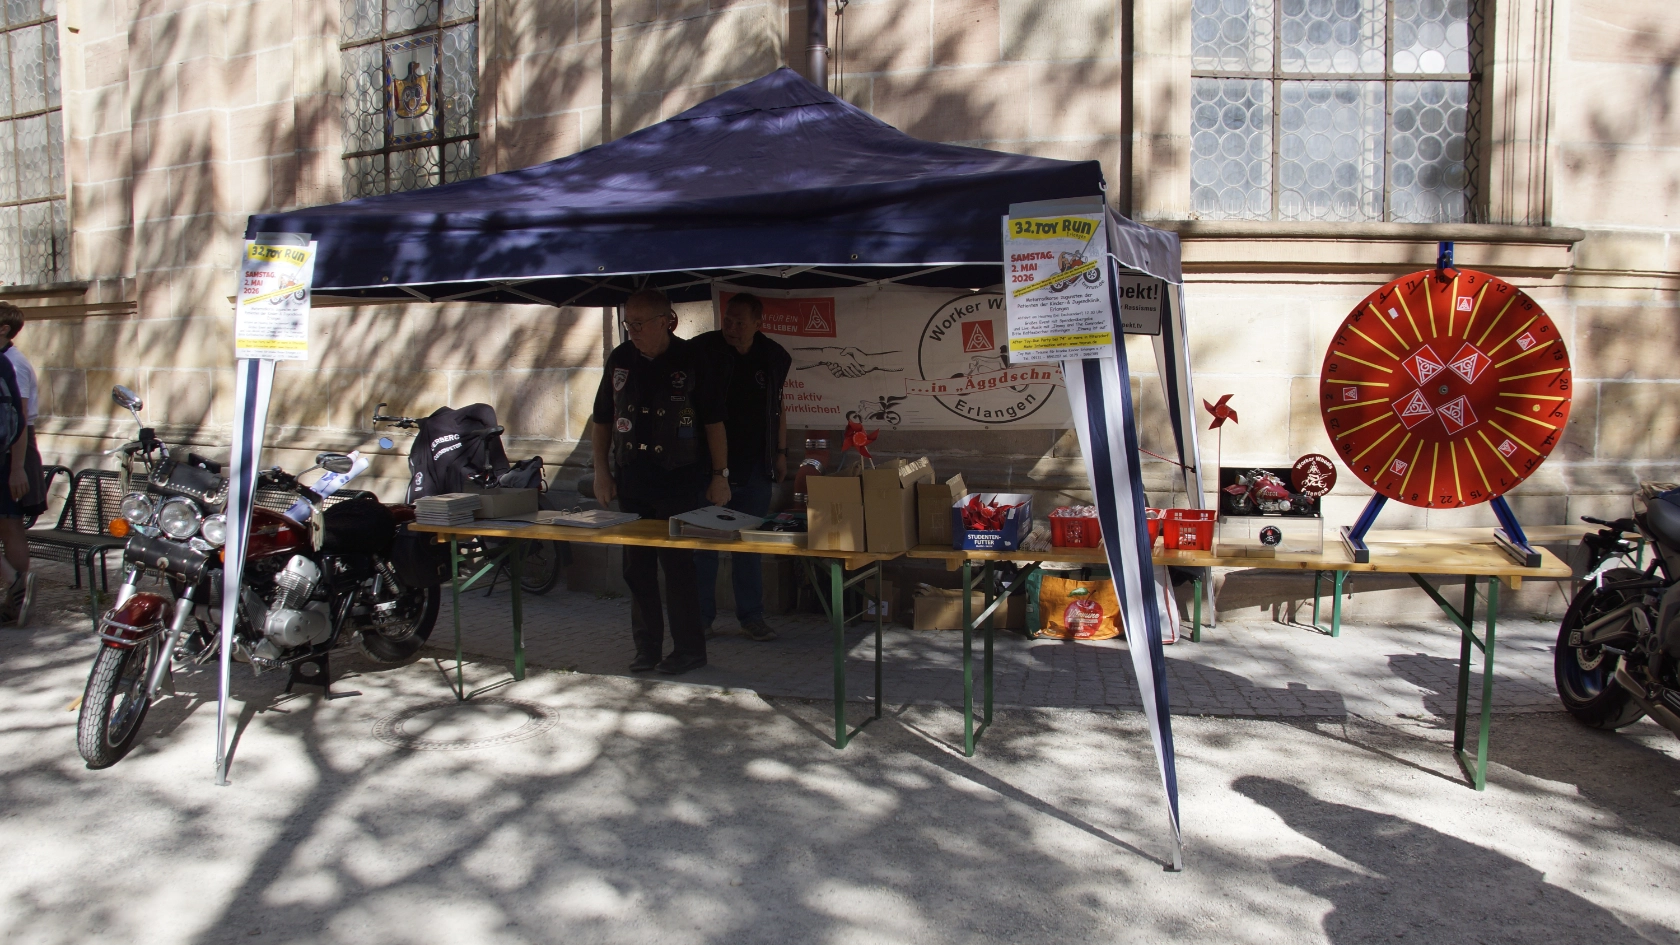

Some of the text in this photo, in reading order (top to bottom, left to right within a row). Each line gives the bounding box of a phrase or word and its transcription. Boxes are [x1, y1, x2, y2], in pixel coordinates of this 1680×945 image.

[1021, 263, 1037, 272] MAI
[1012, 274, 1034, 283] 2026
[1406, 281, 1415, 290] 11
[1496, 284, 1507, 293] 12
[1520, 300, 1532, 311] 19
[769, 313, 784, 322] FÜR
[1352, 310, 1364, 322] 24
[930, 302, 981, 342] Worker
[1337, 336, 1347, 346] 17
[1552, 349, 1564, 360] 13
[1328, 363, 1338, 373] 10
[1559, 379, 1568, 390] 20
[798, 393, 822, 402] aktiv
[955, 393, 1036, 418] Erlangen
[1330, 418, 1340, 429] 23
[1342, 444, 1353, 455] 16
[1296, 456, 1333, 469] Worker Wheels
[1524, 459, 1536, 470] 21
[1500, 478, 1507, 486] 7
[1412, 493, 1418, 501] 8
[1440, 496, 1452, 504] 22
[1470, 490, 1482, 500] 15
